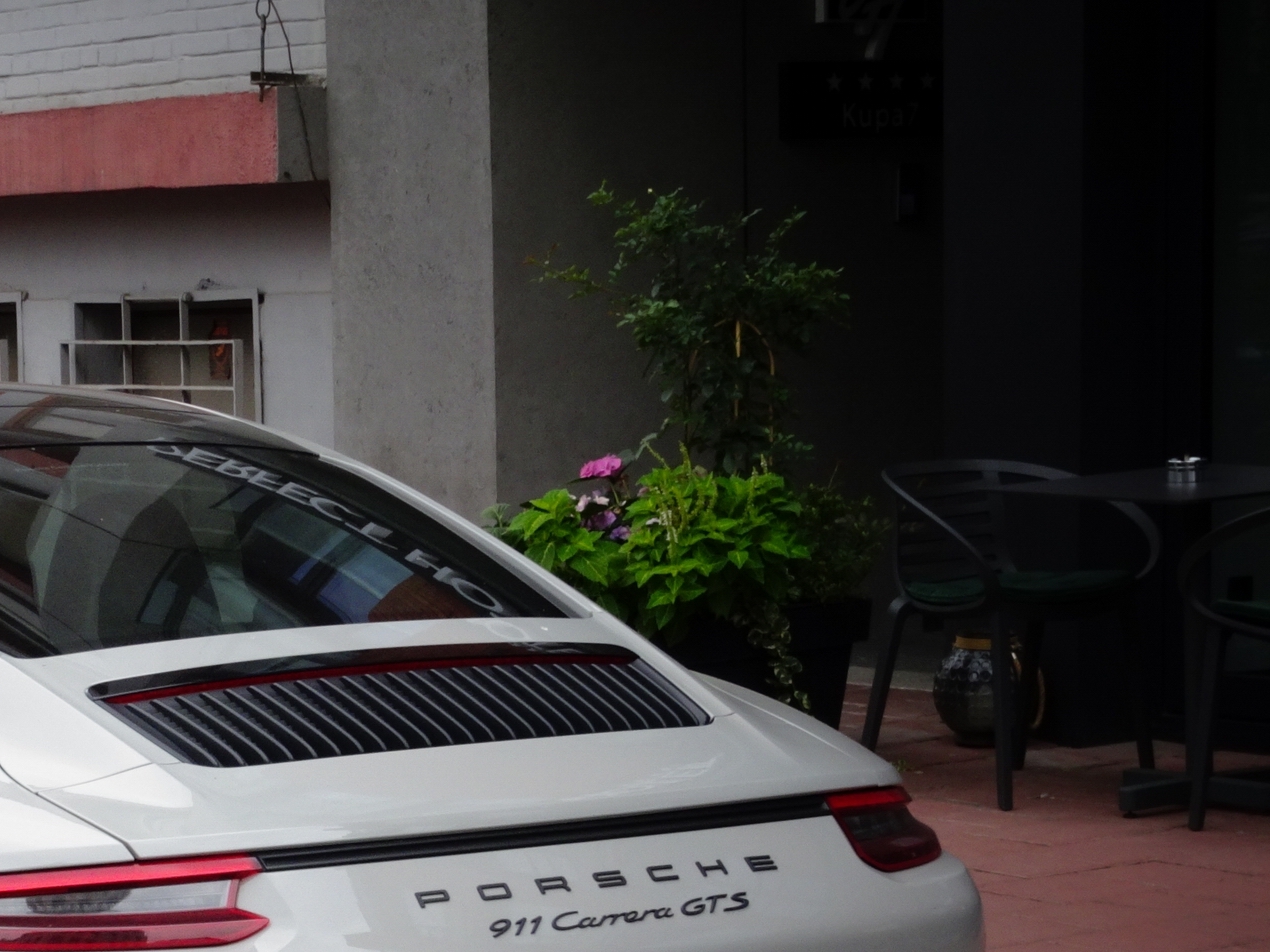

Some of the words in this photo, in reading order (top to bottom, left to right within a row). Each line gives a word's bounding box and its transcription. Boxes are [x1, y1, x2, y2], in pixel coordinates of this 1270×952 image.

[843, 102, 918, 132] Kupa7
[414, 855, 778, 908] PORSCHE
[488, 915, 543, 938] 911
[551, 907, 674, 932] Carrera
[680, 892, 750, 917] GTS
